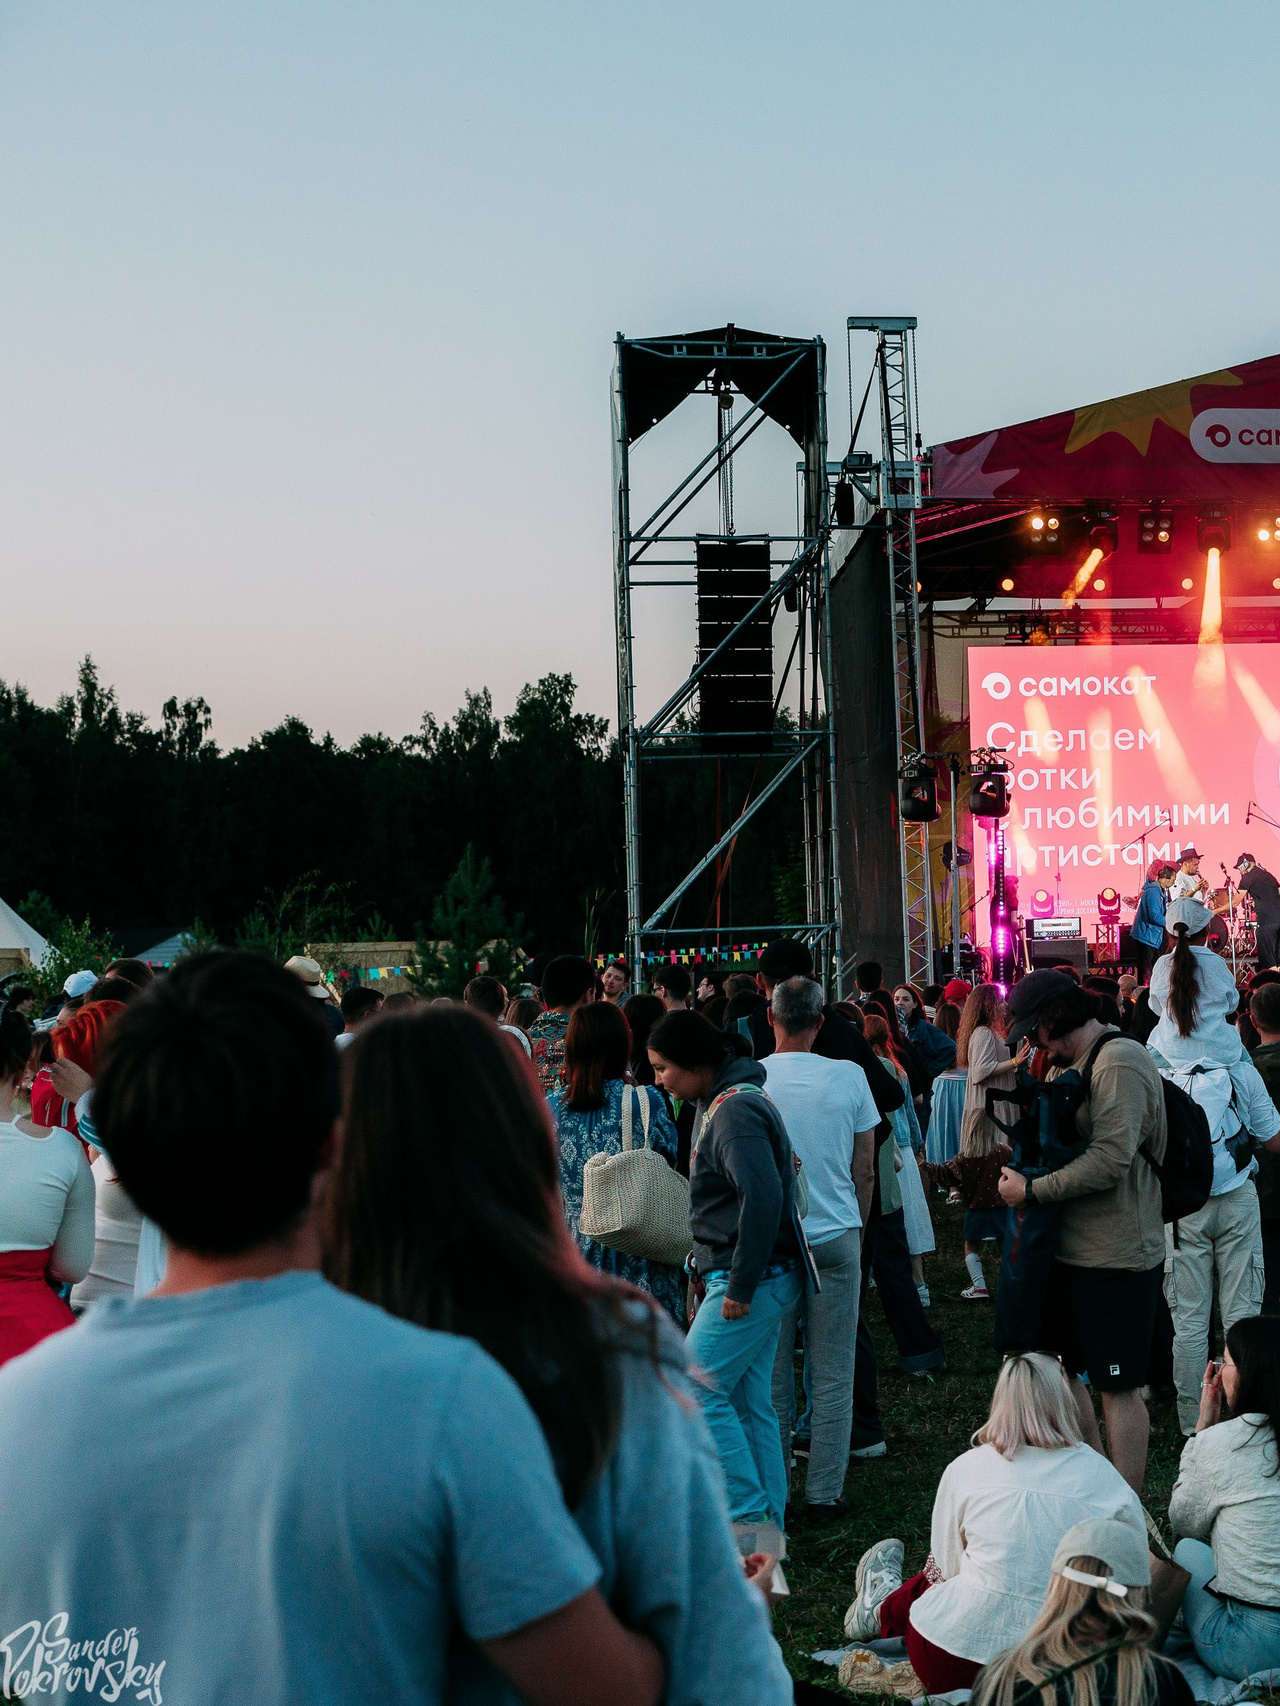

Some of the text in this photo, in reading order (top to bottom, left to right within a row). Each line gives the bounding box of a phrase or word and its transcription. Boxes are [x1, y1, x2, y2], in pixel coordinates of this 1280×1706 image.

[1018, 676, 1157, 697] самокат
[986, 721, 1162, 757] Сделаем
[1022, 797, 1230, 830] любимыми
